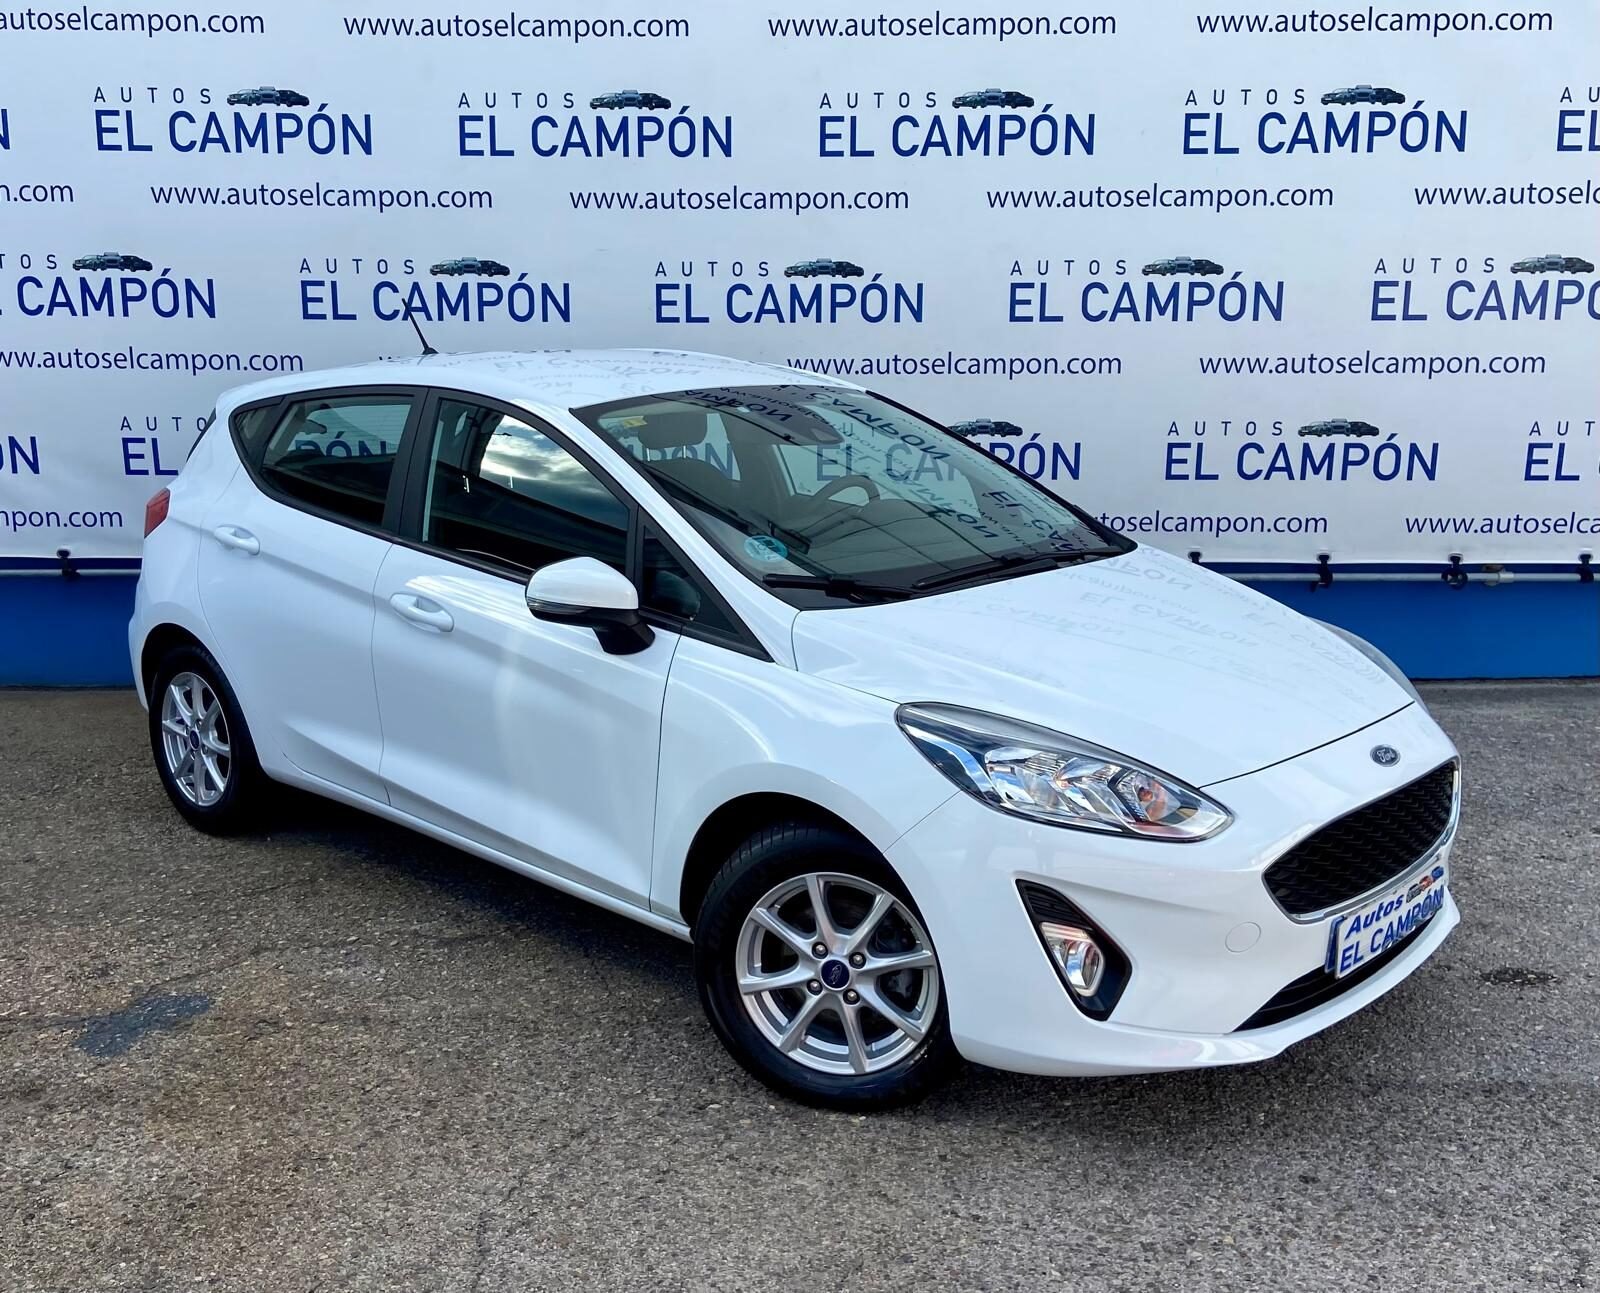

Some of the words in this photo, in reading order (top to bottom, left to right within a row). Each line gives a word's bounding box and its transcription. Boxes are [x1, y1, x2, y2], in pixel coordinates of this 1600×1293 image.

[344, 12, 688, 43] www.autoselcampon.com
[768, 11, 1115, 41] www.autoselcampon.com
[1197, 6, 1552, 37] www.autoselcampon.com
[94, 87, 211, 104] AUTOS
[458, 92, 574, 108] AUTOS
[820, 92, 936, 109] AUTOS
[1185, 89, 1304, 105] AUTOS
[95, 110, 152, 151] EL
[169, 103, 372, 155] CAMPÓN
[459, 115, 514, 156] EL
[532, 106, 731, 157] CAMPÓN
[820, 116, 874, 157] EL
[893, 104, 1095, 157] CAMPÓN
[1183, 113, 1239, 154] EL
[1258, 100, 1467, 154] CAMPÓN
[151, 182, 492, 213] www.autoselcampon.com
[570, 185, 908, 215] www.autoselcampon.com
[987, 183, 1333, 212] www.autoselcampon.com
[300, 258, 414, 274] AUTOS
[655, 262, 768, 277] AUTOS
[1010, 260, 1126, 275] AUTOS
[1375, 258, 1494, 274] AUTOS
[17, 268, 215, 318] CAMPÓN
[301, 280, 357, 320] EL
[373, 273, 570, 322] CAMPÓN
[656, 284, 709, 323] EL
[727, 273, 923, 323] CAMPÓN
[1009, 283, 1063, 322] EL
[1082, 272, 1284, 322] CAMPÓN
[1371, 281, 1427, 321] EL
[787, 352, 1121, 380] www.autoselcampon.com
[1200, 351, 1545, 379] www.autoselcampon.com
[1168, 421, 1282, 436] AUTOS
[122, 438, 179, 476] EL
[1165, 443, 1219, 480] EL
[1237, 433, 1438, 481] CAMPÓN
[1524, 443, 1580, 481] EL
[1095, 510, 1327, 538] toselcampon.com
[1344, 894, 1404, 940] Autos
[1340, 941, 1364, 973] EL
